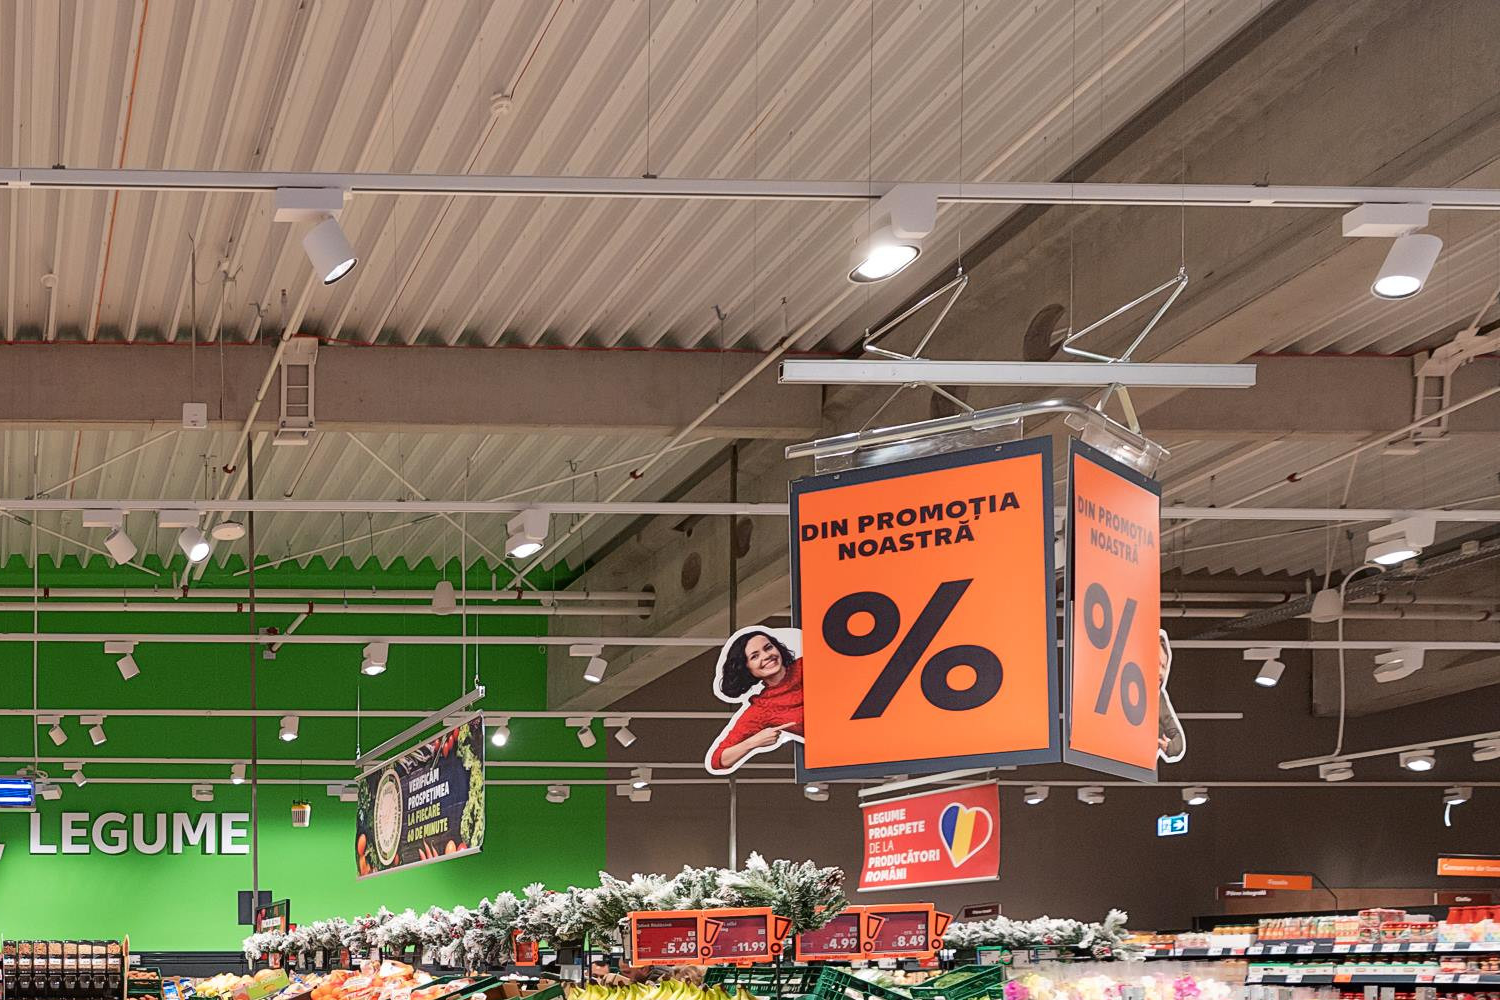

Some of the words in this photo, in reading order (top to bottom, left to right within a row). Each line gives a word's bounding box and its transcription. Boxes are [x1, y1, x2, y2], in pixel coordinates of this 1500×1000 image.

[801, 517, 848, 542] DIN
[858, 492, 1020, 532] PROMOȚIA
[1077, 495, 1096, 519] DIN
[1098, 505, 1155, 548] PROMOȚIA
[838, 522, 975, 560] NOASTRĂ
[1090, 527, 1139, 565] NOASTRĂ
[822, 578, 1004, 721] %
[408, 812, 415, 826] LA
[416, 802, 441, 823] FIECARE
[868, 809, 906, 825] LEGUME
[30, 811, 250, 854] LEGUME
[415, 825, 423, 840] DE
[424, 817, 448, 837] MINUTE
[868, 820, 925, 839] PROASPETE
[869, 842, 880, 854] DE
[883, 840, 894, 852] LA
[868, 848, 940, 868] PRODUCĂTORI
[864, 867, 907, 882] ROMÂNI
[667, 942, 696, 954] 5.49
[738, 941, 766, 953] 11.99
[829, 938, 857, 949] 4.99
[897, 935, 925, 947] 8.49
